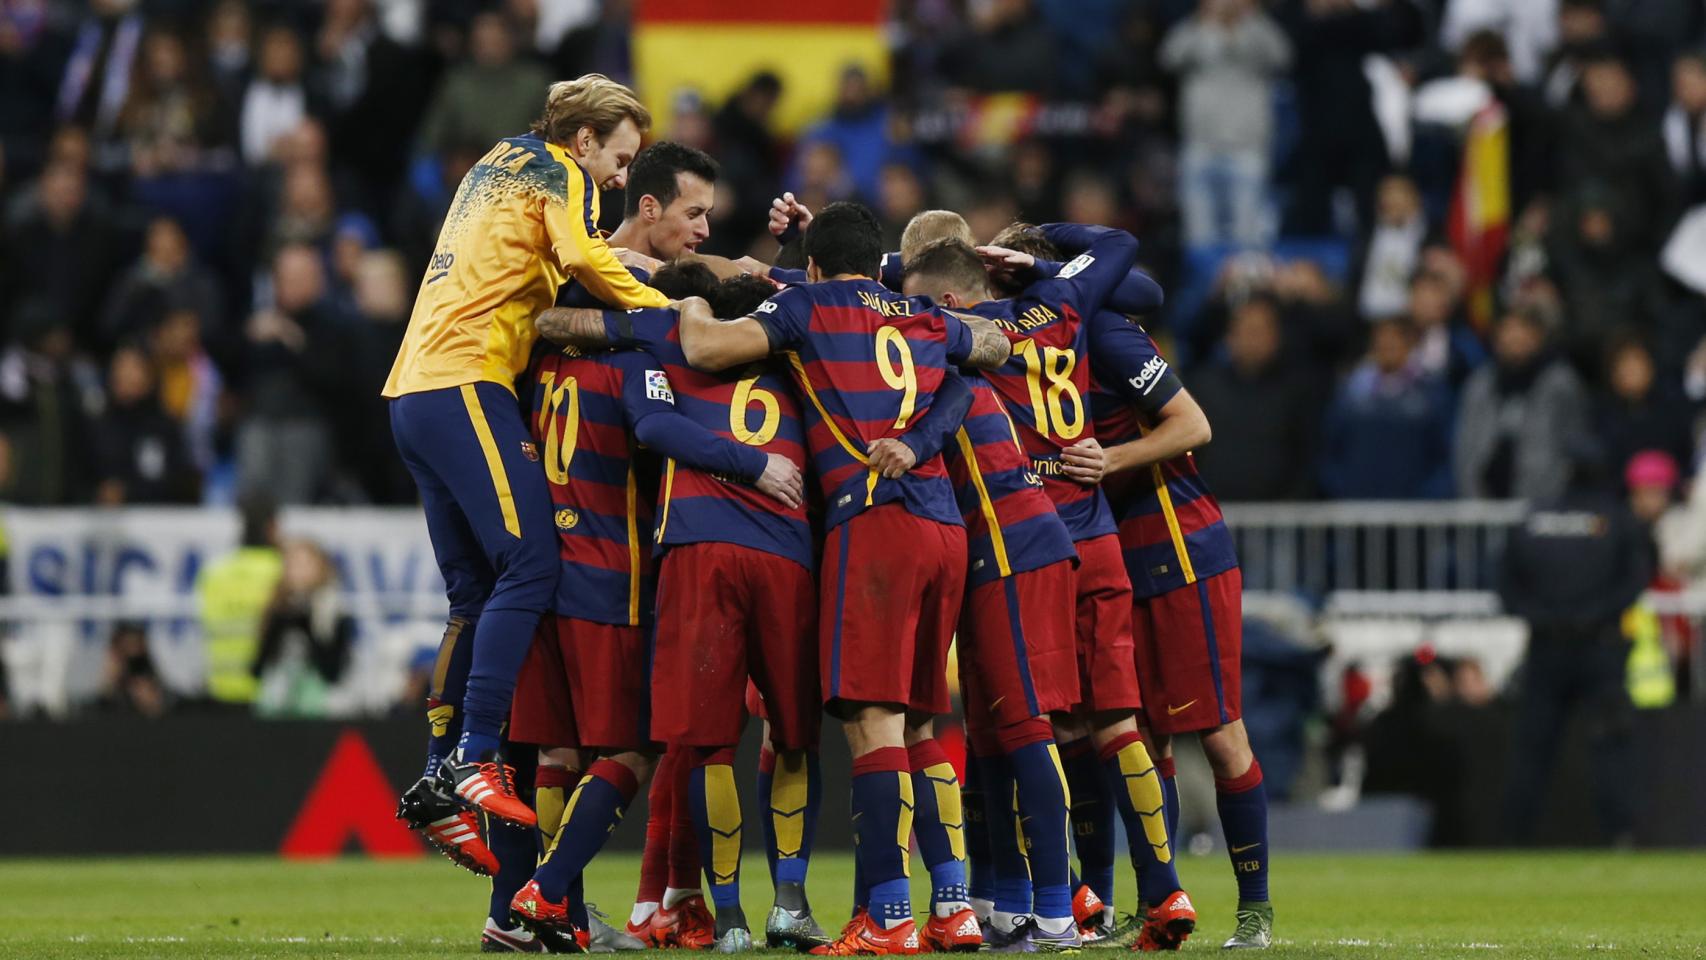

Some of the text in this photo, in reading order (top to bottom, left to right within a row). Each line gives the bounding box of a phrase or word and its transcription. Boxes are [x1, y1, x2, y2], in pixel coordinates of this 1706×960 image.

[1018, 304, 1059, 331] ALBA
[729, 375, 781, 447] 6
[874, 325, 918, 431] 9
[1012, 338, 1086, 441] 18
[1128, 354, 1165, 390] beko
[538, 370, 580, 486] 10
